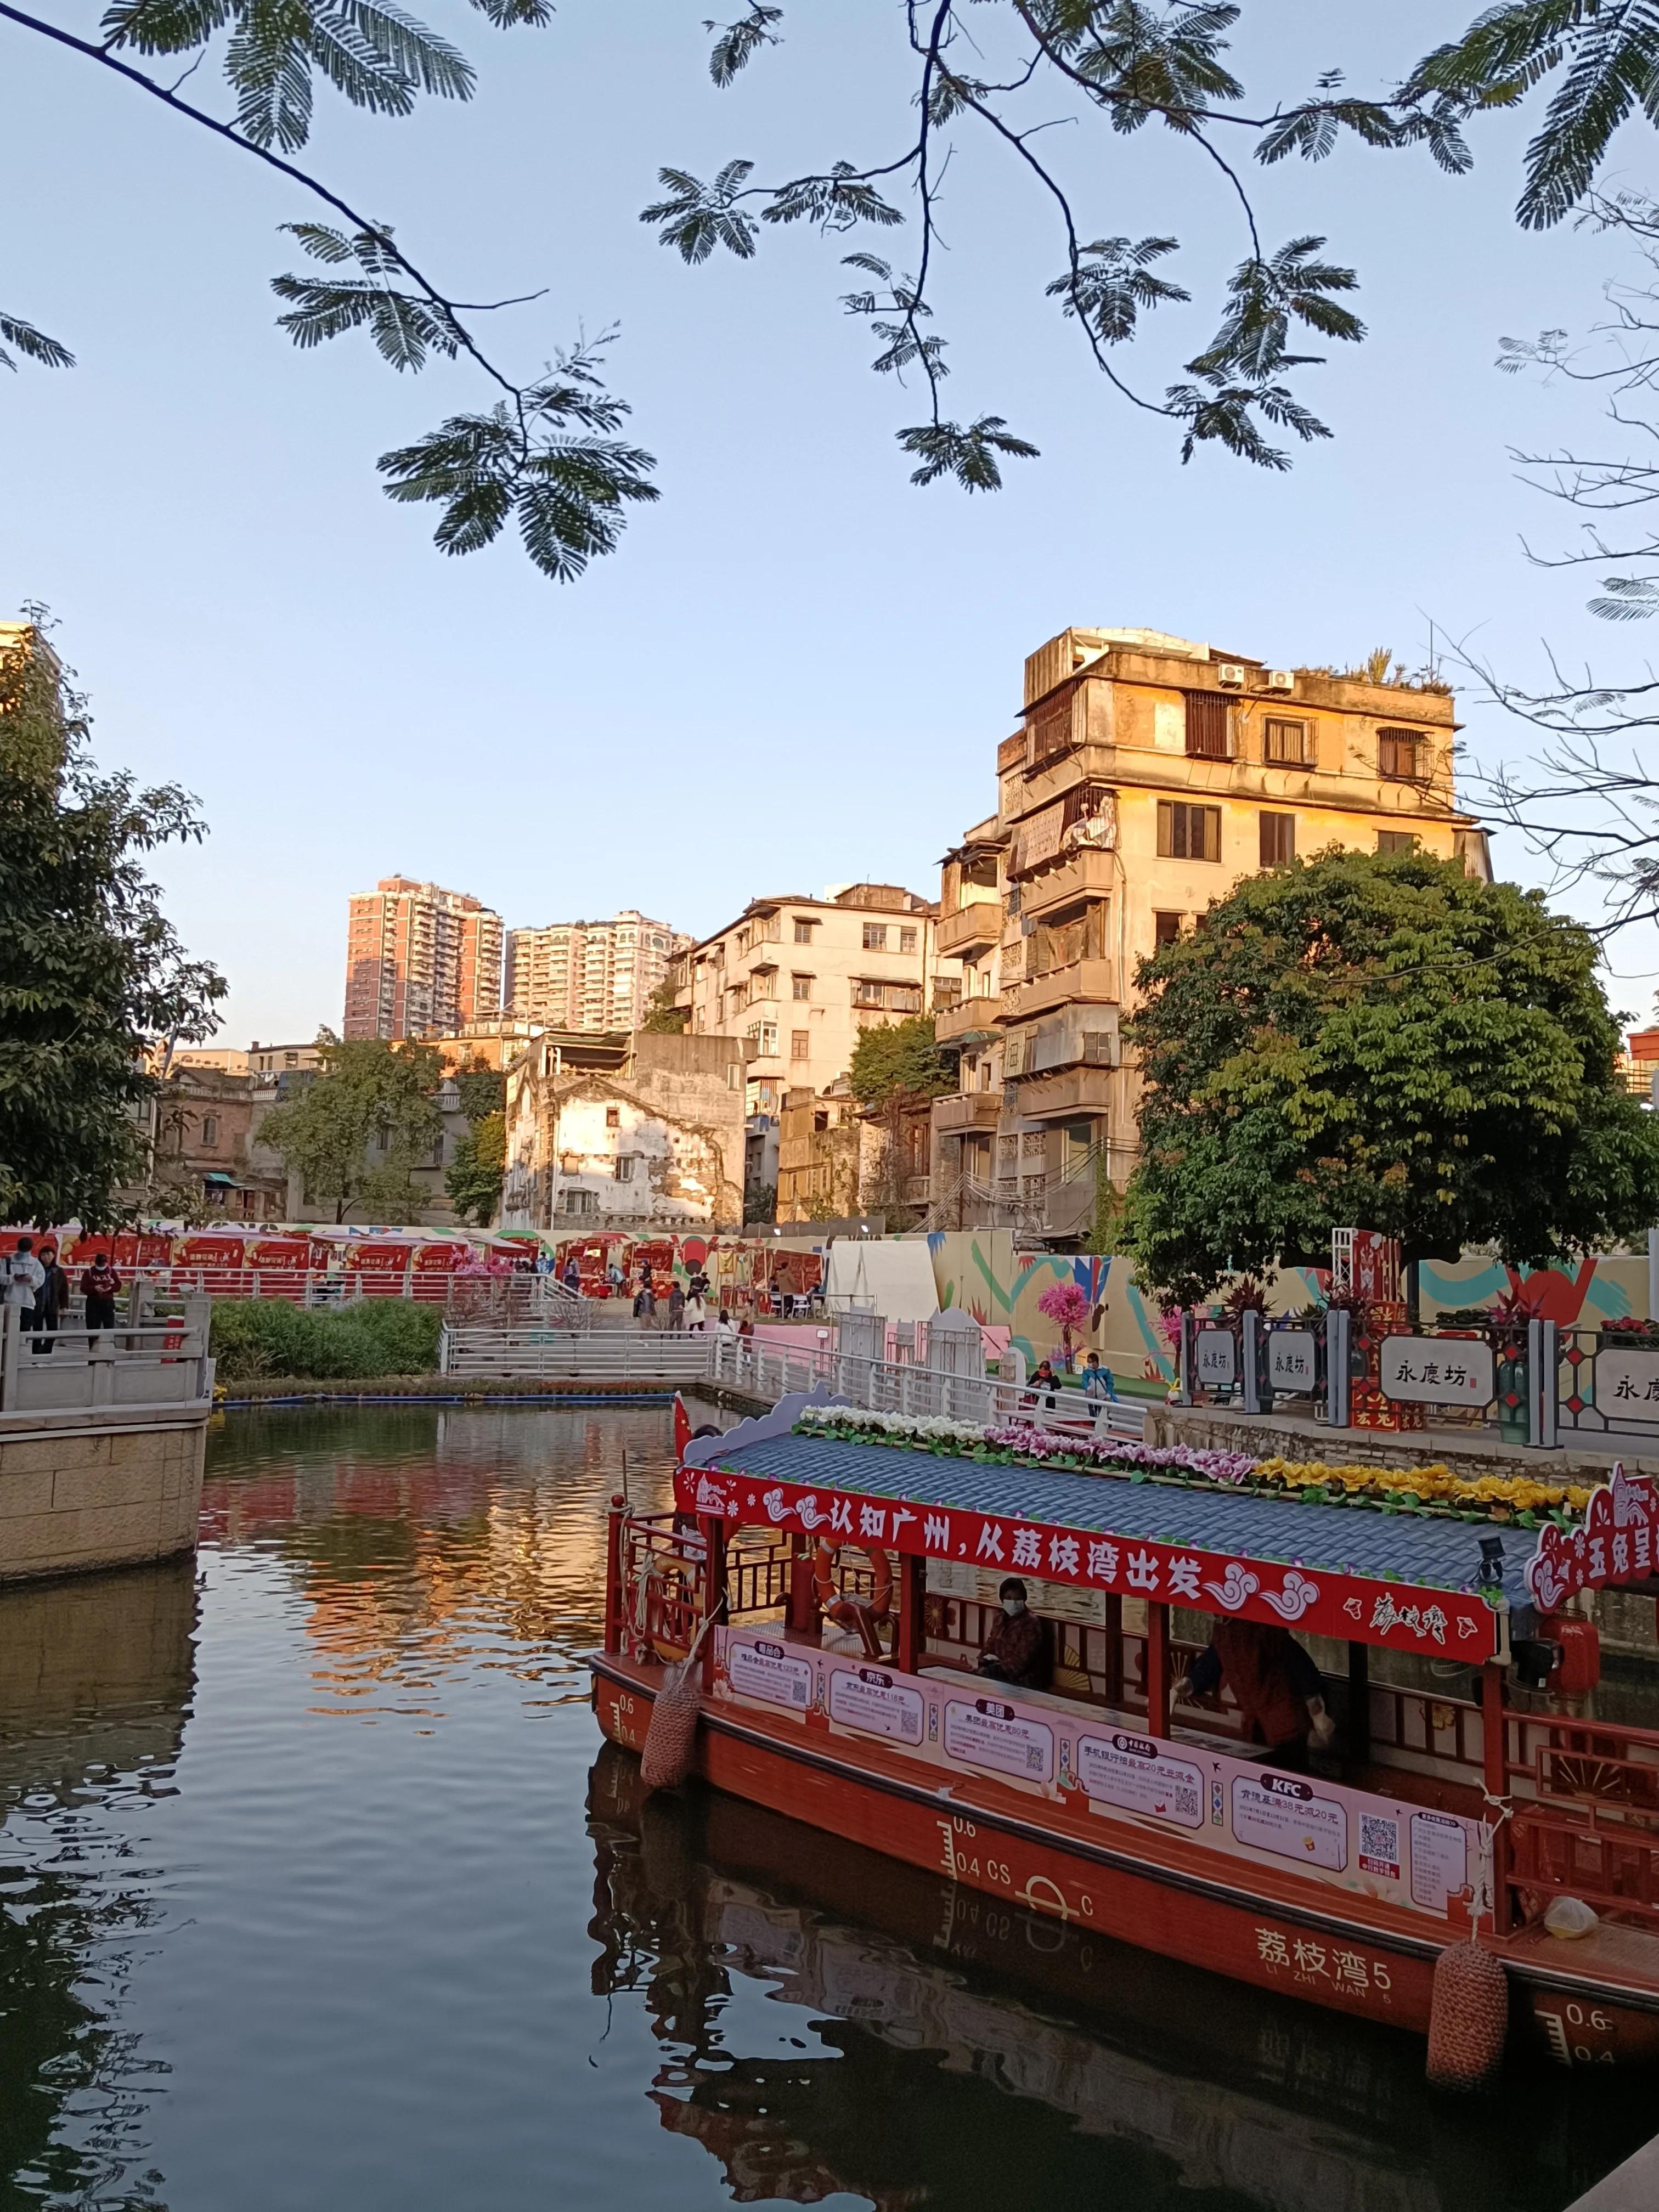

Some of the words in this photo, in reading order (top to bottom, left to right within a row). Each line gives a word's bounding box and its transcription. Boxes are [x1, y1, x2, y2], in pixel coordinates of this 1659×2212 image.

[1589, 1525, 1659, 1579] 玉兔呈
[759, 1644, 781, 1657] 唯品会
[867, 1672, 885, 1686] 京东
[620, 1694, 634, 1714] 0.6
[986, 1702, 1005, 1718] 美团
[1271, 1778, 1302, 1797] KFC
[953, 1816, 976, 1837] 0.6
[957, 1852, 980, 1877] 0.4
[988, 1859, 1011, 1885] CS
[1265, 1962, 1278, 1975] LI
[1293, 1970, 1316, 1985] ZHI
[1331, 1980, 1365, 1998] WAN
[1383, 1993, 1391, 2004] 5
[1566, 2004, 1607, 2030] 0.6
[1574, 2045, 1615, 2064] 0.4
